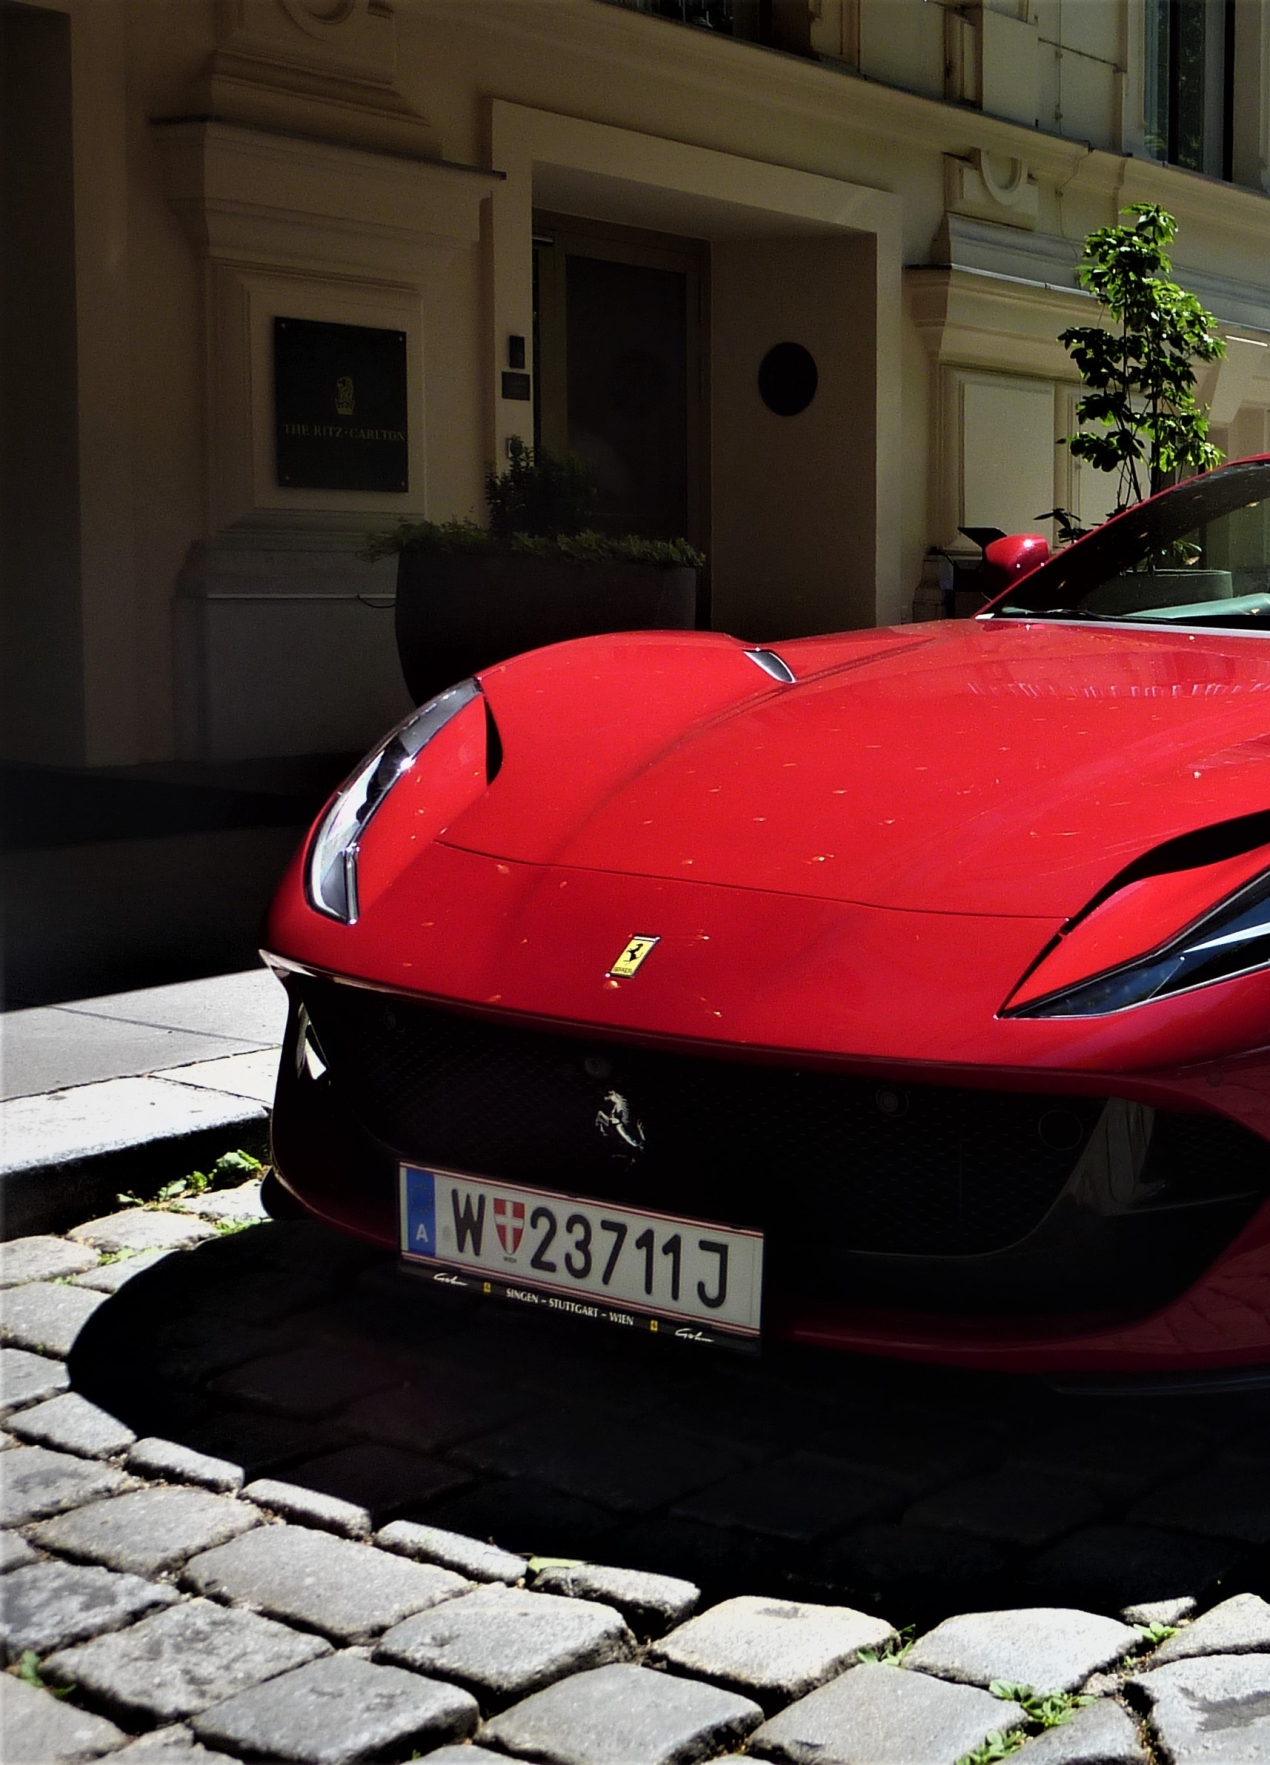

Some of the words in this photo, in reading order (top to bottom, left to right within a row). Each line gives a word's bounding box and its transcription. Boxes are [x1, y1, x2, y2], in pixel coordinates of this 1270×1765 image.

[283, 424, 309, 436] THE
[415, 1223, 429, 1243] A
[451, 1189, 486, 1257] W
[506, 1288, 539, 1304] SINGEN
[548, 1298, 599, 1318] STUTTGART
[609, 1311, 634, 1326] WIEN
